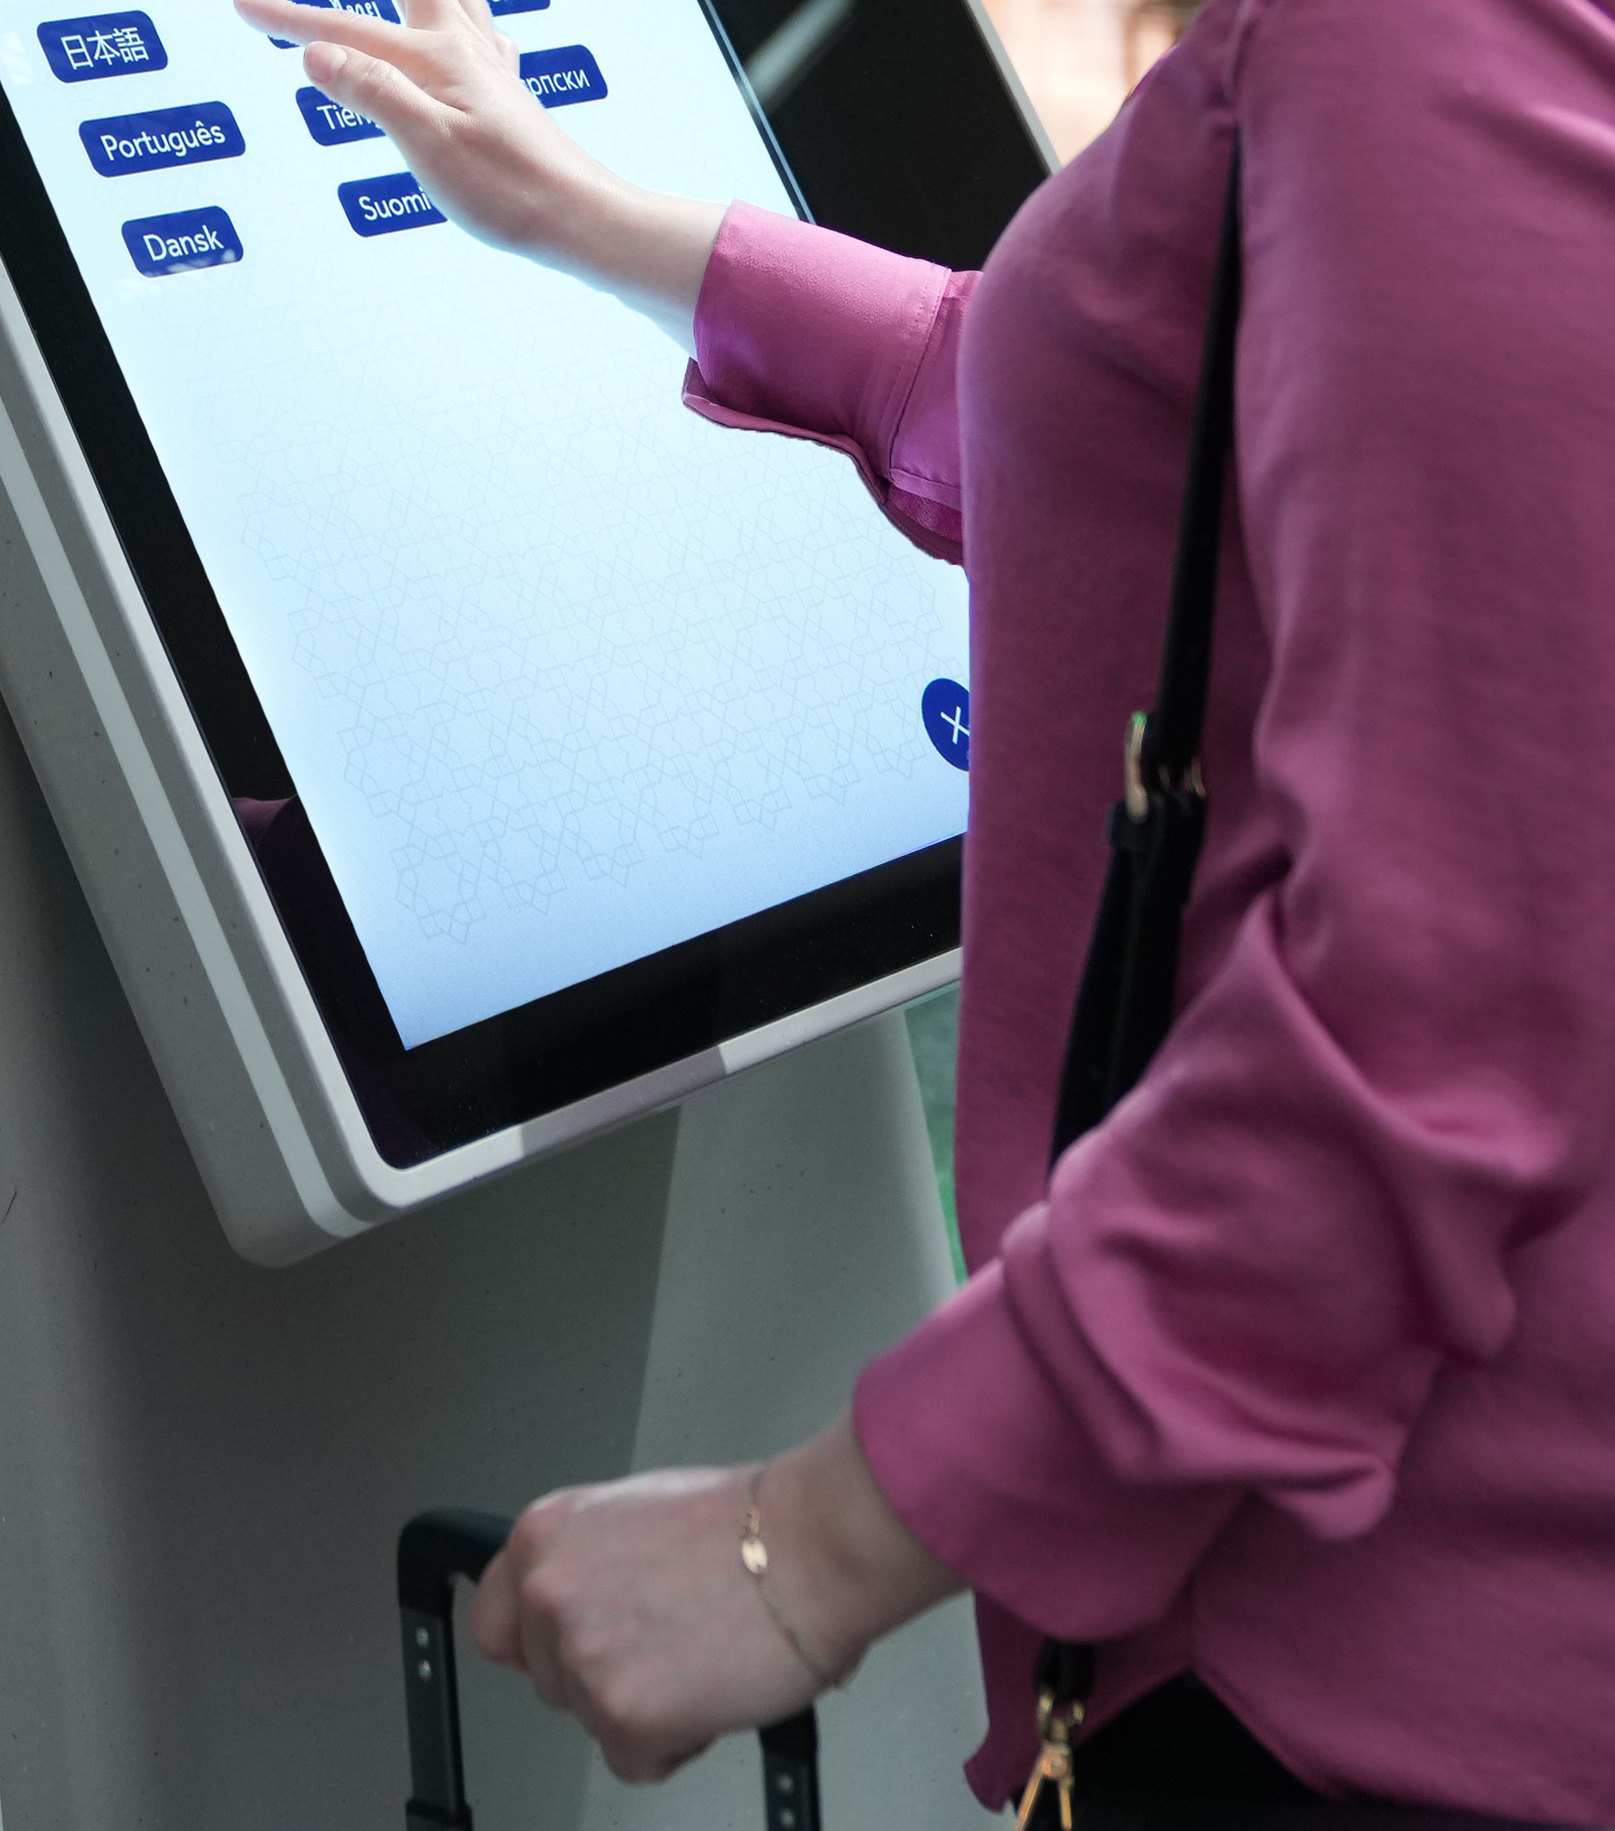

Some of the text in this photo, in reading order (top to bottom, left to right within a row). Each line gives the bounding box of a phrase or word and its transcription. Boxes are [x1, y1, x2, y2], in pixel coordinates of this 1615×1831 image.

[60, 27, 150, 70] 日本語
[520, 68, 591, 97] рпски
[99, 120, 226, 158] Português
[358, 186, 432, 222] Suomi
[143, 224, 224, 261] Dansk
